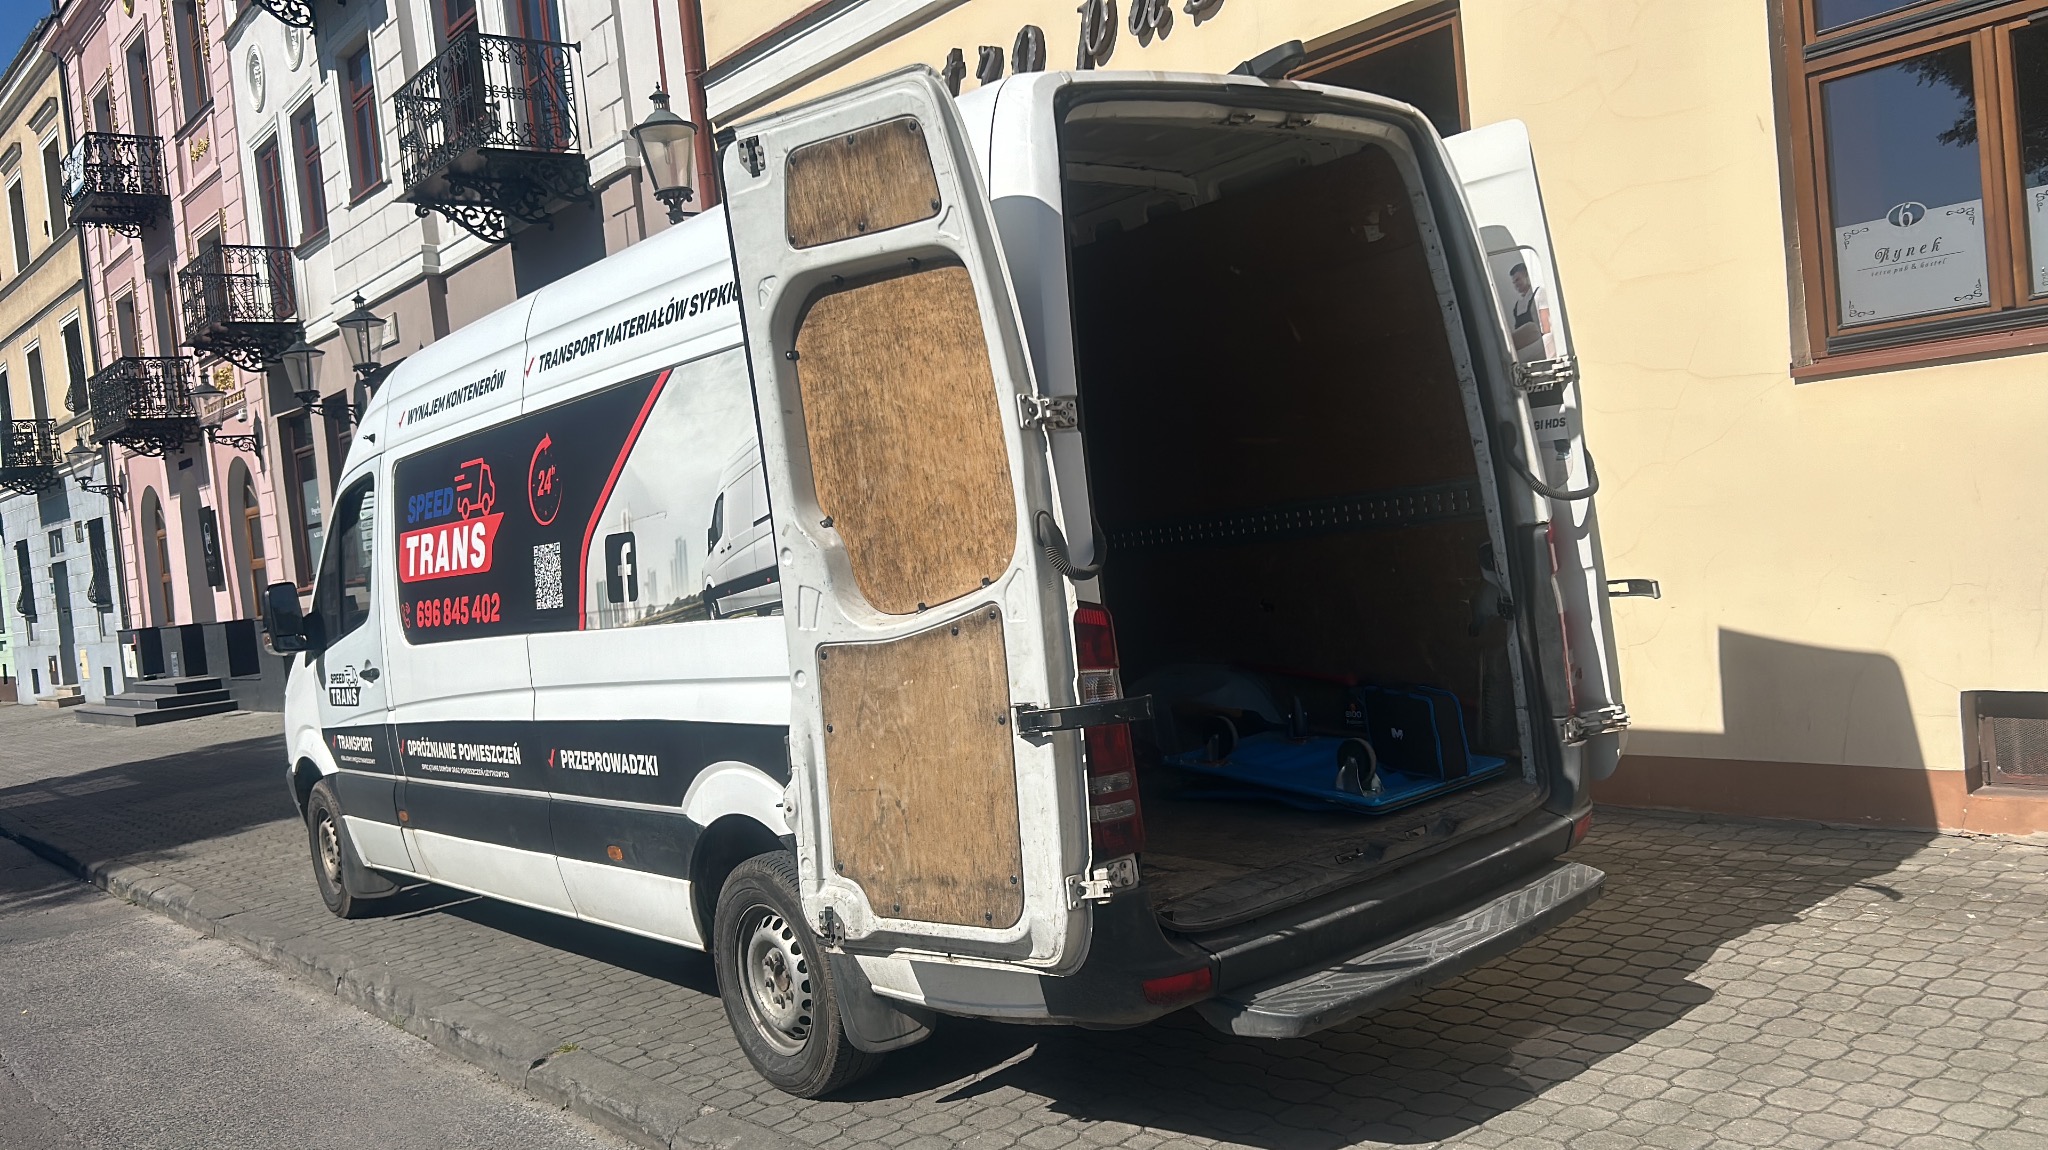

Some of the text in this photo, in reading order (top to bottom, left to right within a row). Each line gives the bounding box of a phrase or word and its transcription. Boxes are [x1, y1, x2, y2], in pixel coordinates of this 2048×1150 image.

[1898, 203, 1913, 226] 6
[1875, 237, 1942, 263] Rynek
[538, 329, 604, 373] TRANSPORT
[603, 296, 689, 348] MATERIAŁÓW
[407, 369, 507, 425] WYNAJEM KONTENERÓW
[407, 486, 454, 524] SPEED
[405, 521, 486, 577] TRANS
[416, 592, 500, 628] 696 845 402
[330, 673, 345, 684] SPEED
[330, 688, 358, 706] TRANS
[336, 734, 373, 753] TRANSPORT
[407, 736, 522, 765] OPRÓŻNIANIE POMIESZCZEŃ
[560, 749, 659, 776] PRZEPROWADZKI
